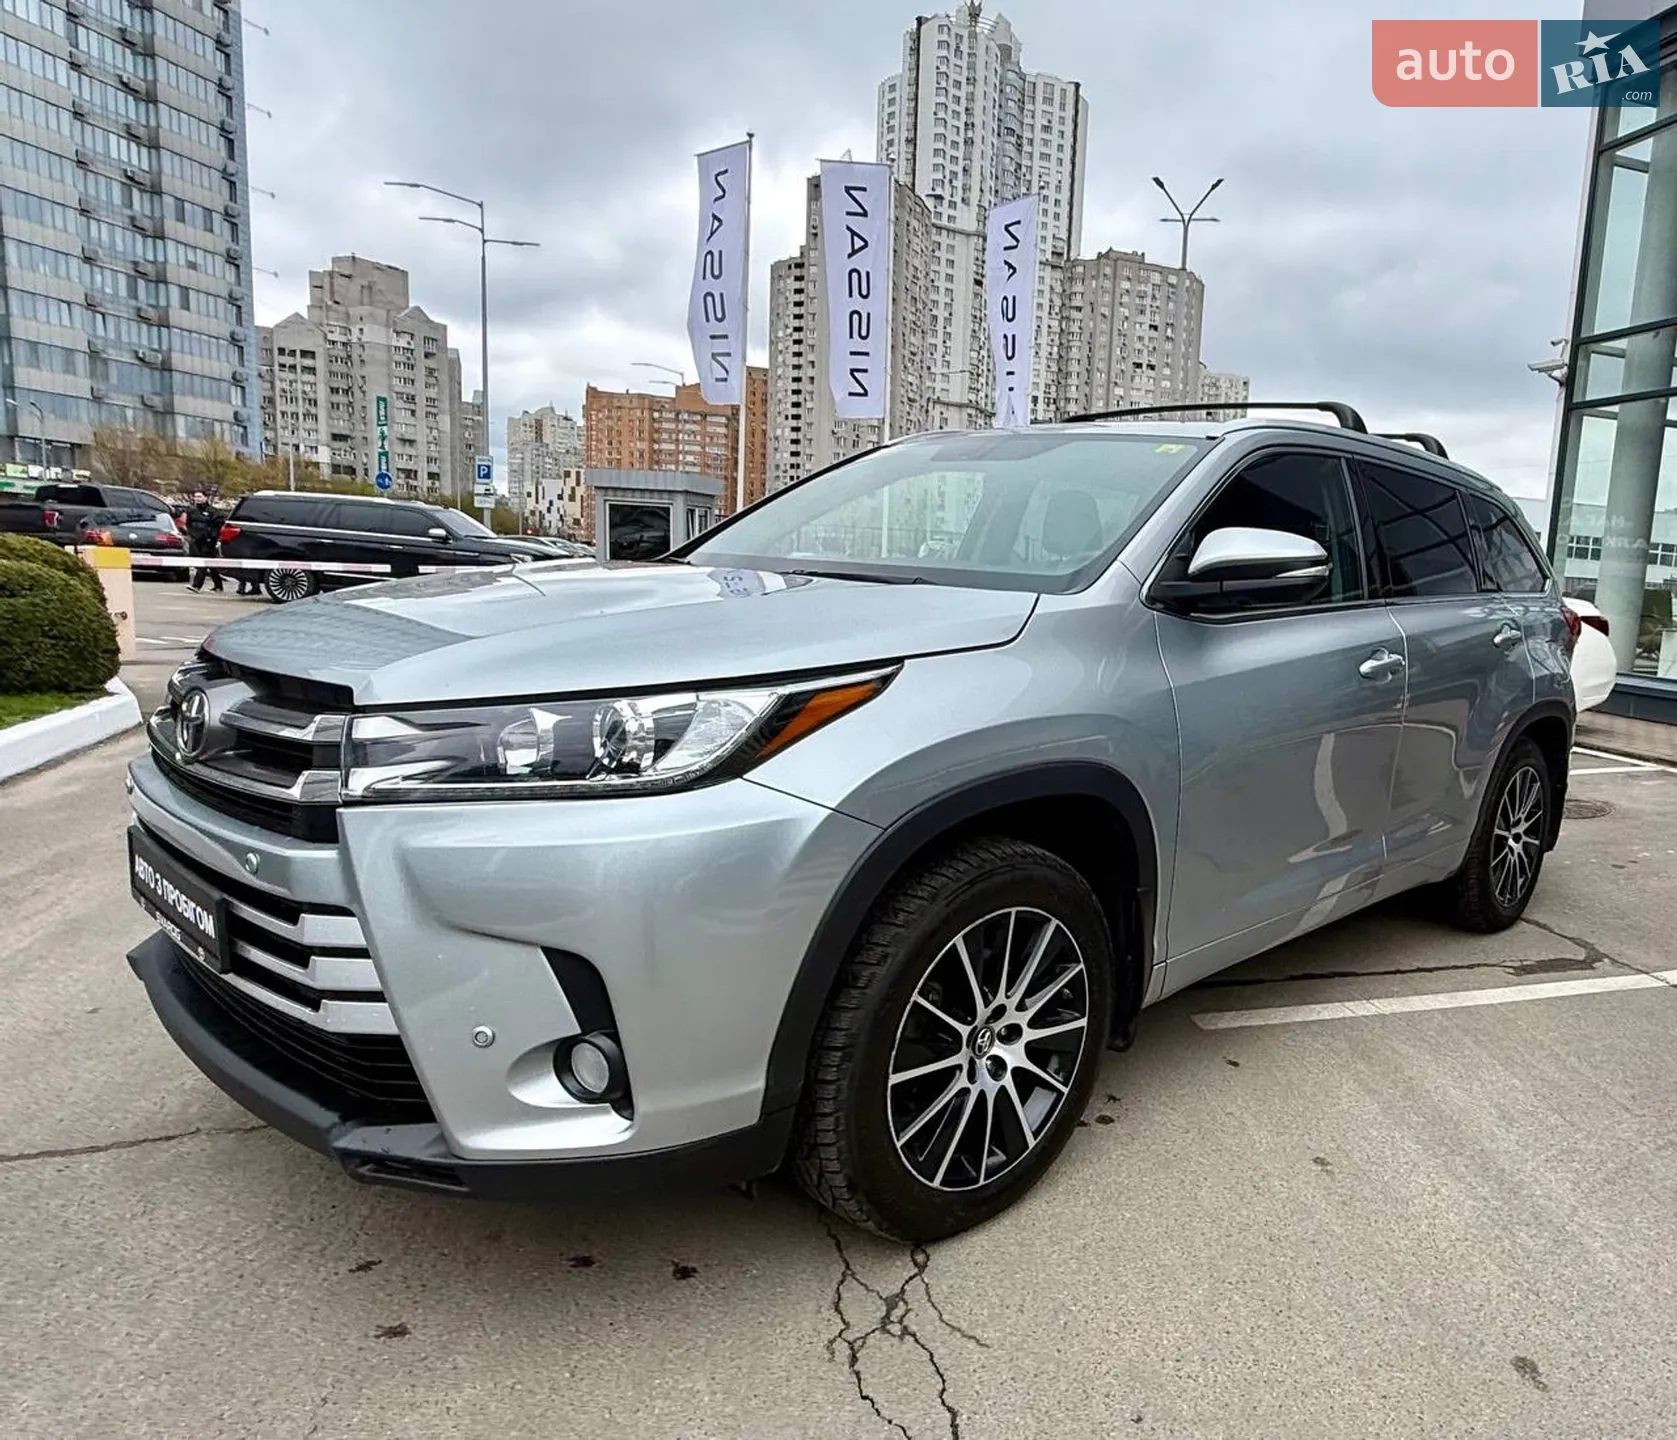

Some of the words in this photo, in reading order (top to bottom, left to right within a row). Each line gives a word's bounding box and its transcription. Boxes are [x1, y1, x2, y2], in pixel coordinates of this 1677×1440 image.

[480, 465, 489, 478] P
[135, 854, 155, 889] АВТО
[163, 878, 216, 939] ПРОБІГОМ
